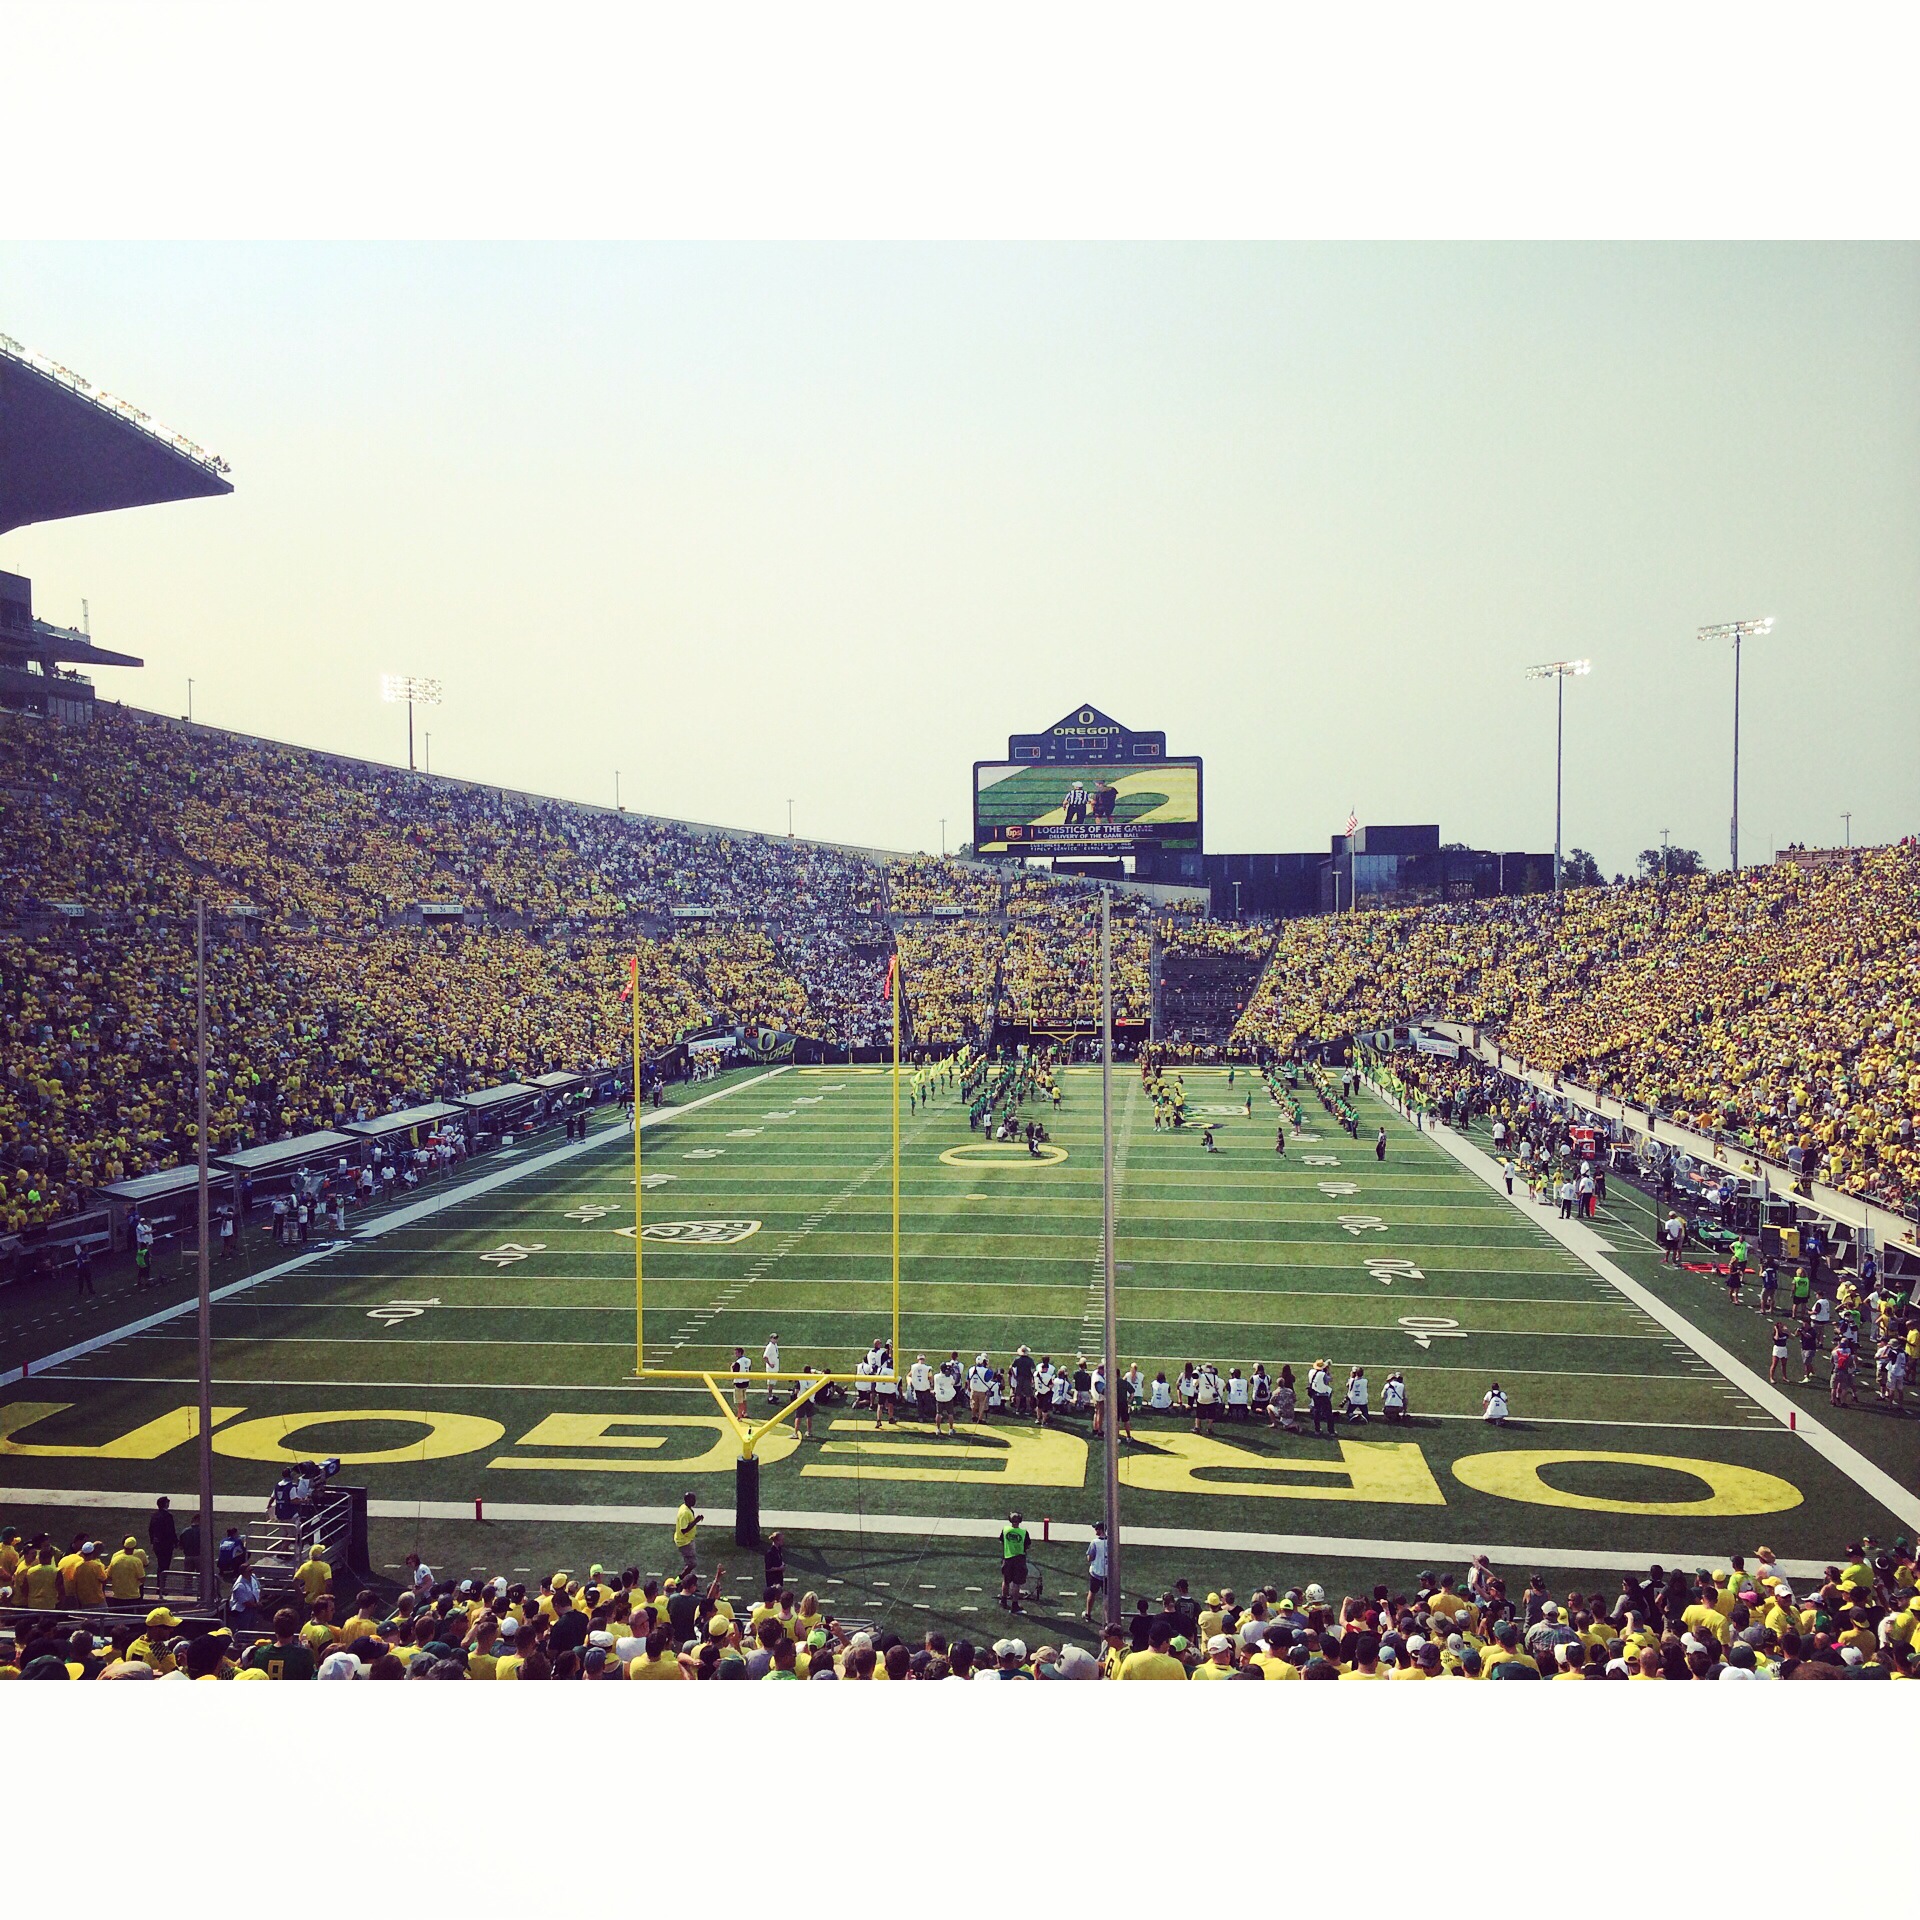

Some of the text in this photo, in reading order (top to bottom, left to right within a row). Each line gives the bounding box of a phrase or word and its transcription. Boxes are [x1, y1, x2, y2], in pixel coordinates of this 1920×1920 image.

[1078, 711, 1094, 725] O
[1053, 727, 1120, 736] OREGON
[1037, 826, 1086, 834] LOGISTICS
[1088, 825, 1101, 833] OF
[1103, 825, 1122, 833] THE
[745, 1029, 758, 1038] 25
[757, 1032, 777, 1051] O
[1300, 1155, 1342, 1166] 50
[1317, 1181, 1362, 1195] 40
[563, 1204, 621, 1219] 30
[1336, 1215, 1389, 1232] 30
[479, 1242, 547, 1261] 20
[1362, 1258, 1425, 1279] 20
[366, 1297, 442, 1319] 10
[1397, 1316, 1468, 1338] 10
[0, 1401, 1805, 1517] OREGON
